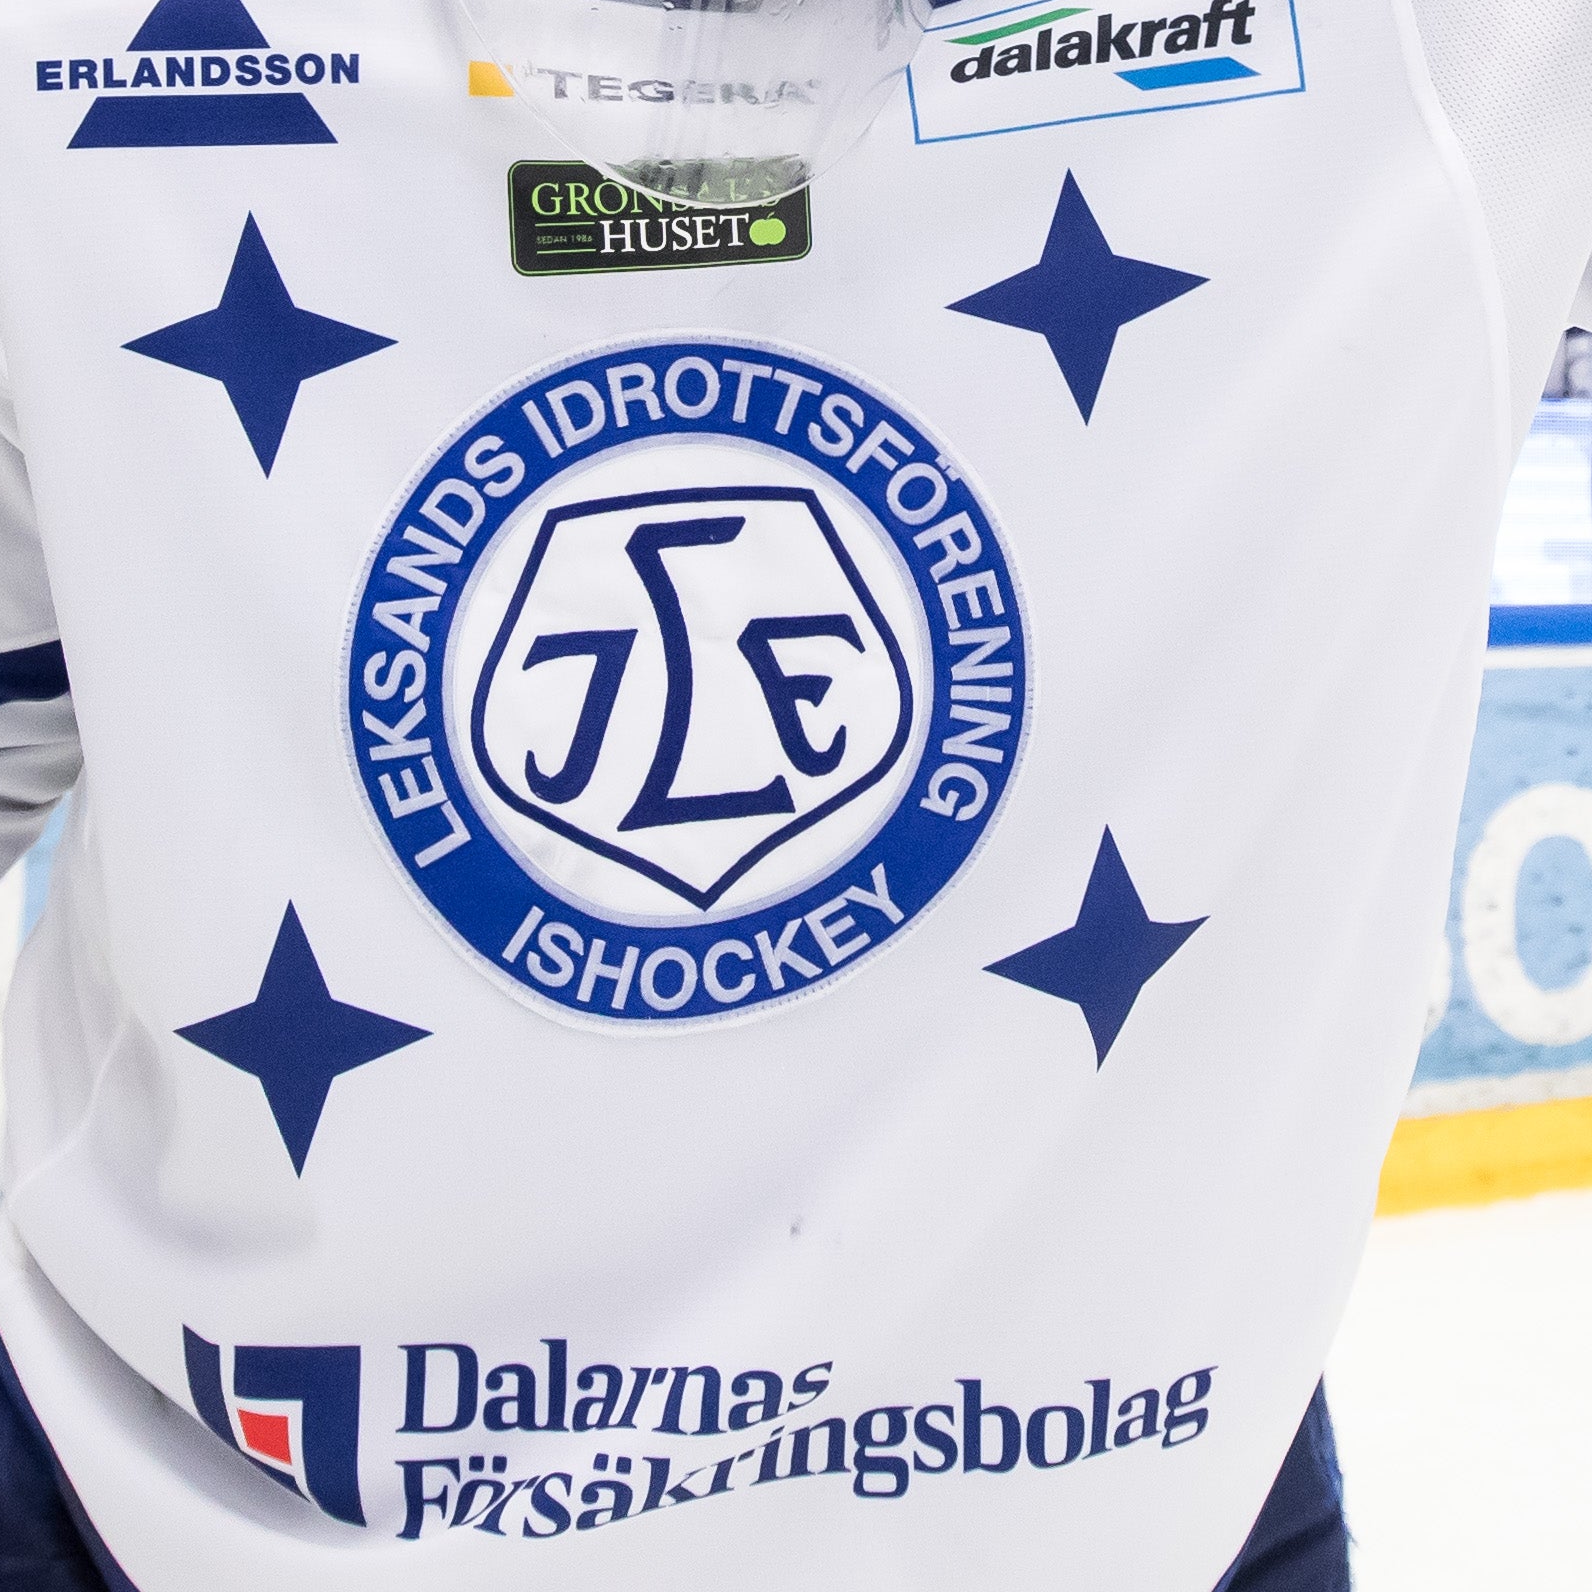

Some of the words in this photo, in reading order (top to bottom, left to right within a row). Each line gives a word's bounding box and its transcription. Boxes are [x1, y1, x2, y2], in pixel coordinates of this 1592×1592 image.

[35, 53, 361, 91] ERLANDSSON
[599, 212, 751, 254] HUSET
[362, 434, 528, 869] LEKSANDS
[520, 356, 1015, 824] IDROTTSFÖRENING
[501, 862, 906, 1012] ISHOCKEY
[394, 1338, 834, 1437] Dalarnas
[394, 1365, 1220, 1541] Försäkringsbolag
